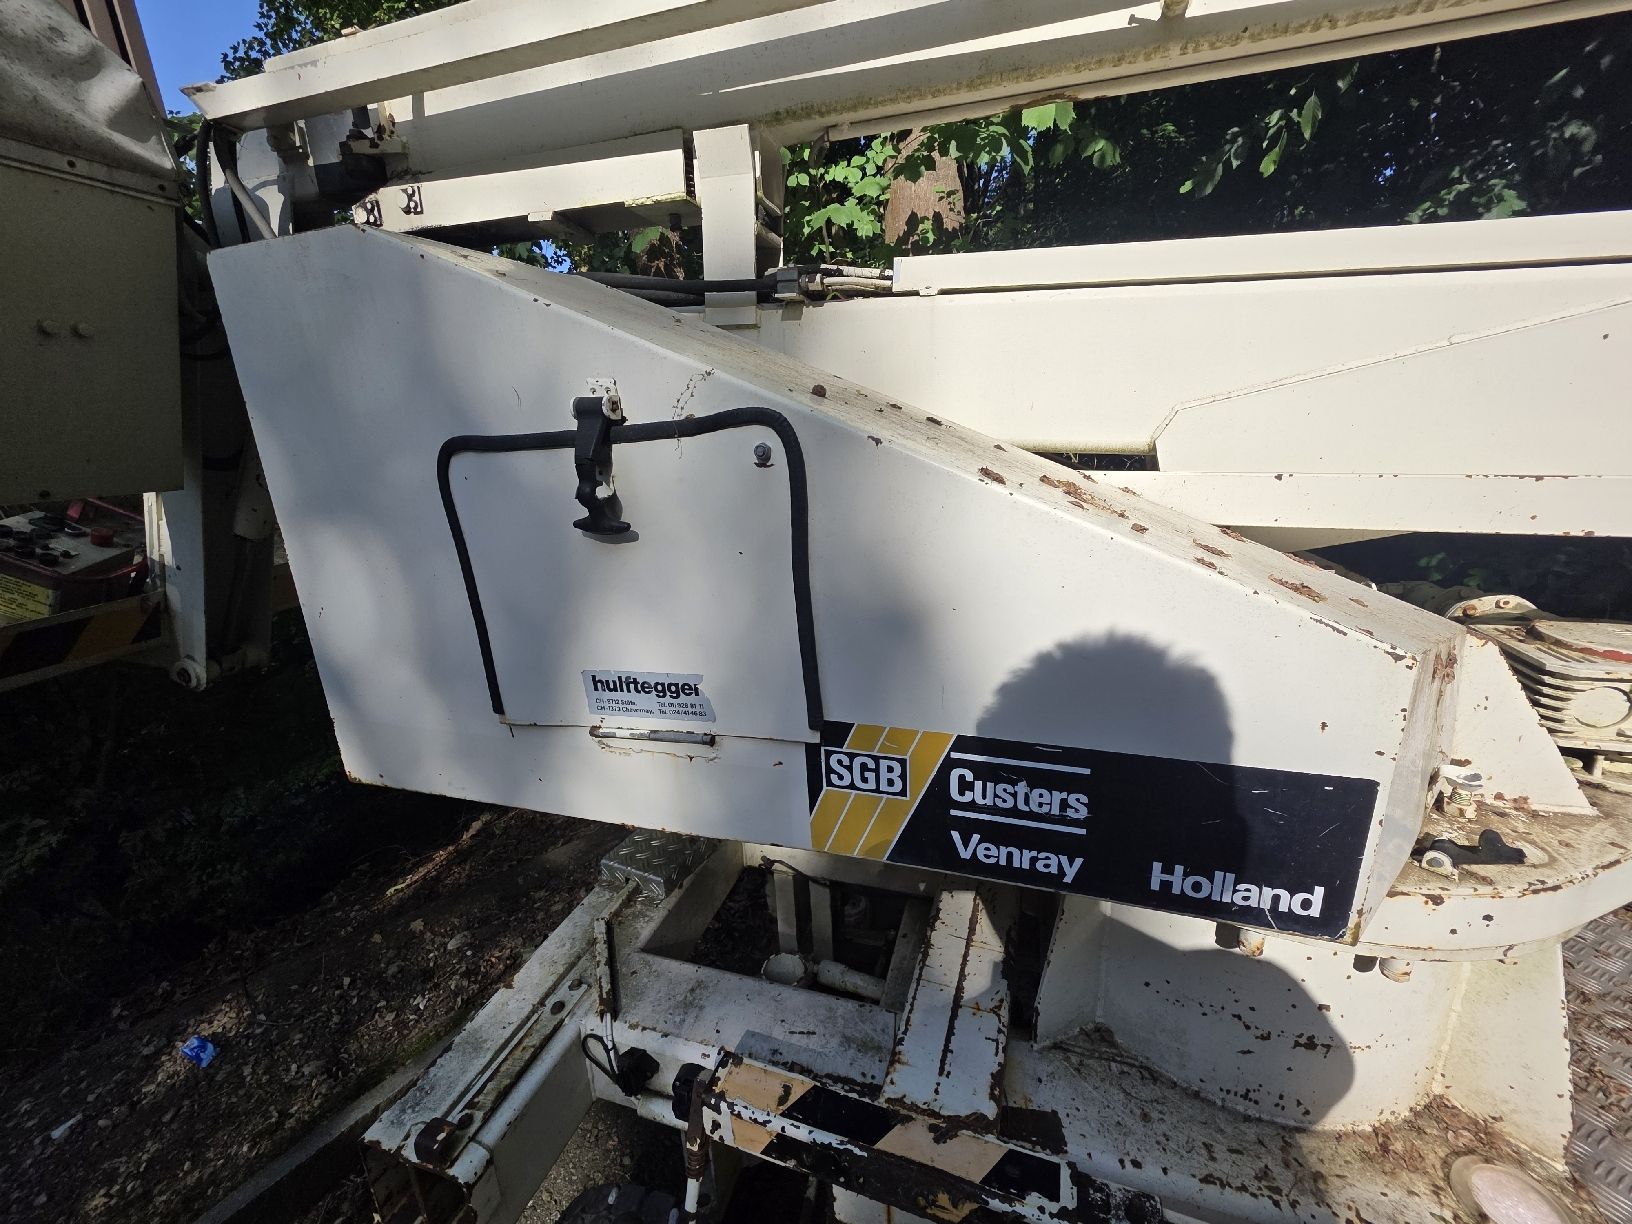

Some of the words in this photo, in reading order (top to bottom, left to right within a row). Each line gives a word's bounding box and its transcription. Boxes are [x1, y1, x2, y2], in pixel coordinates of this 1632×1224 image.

[590, 674, 699, 699] hulftegger
[828, 751, 904, 794] SGB
[949, 766, 1089, 819] Custers
[950, 829, 1084, 884] Venray
[1150, 861, 1325, 918] Holland
